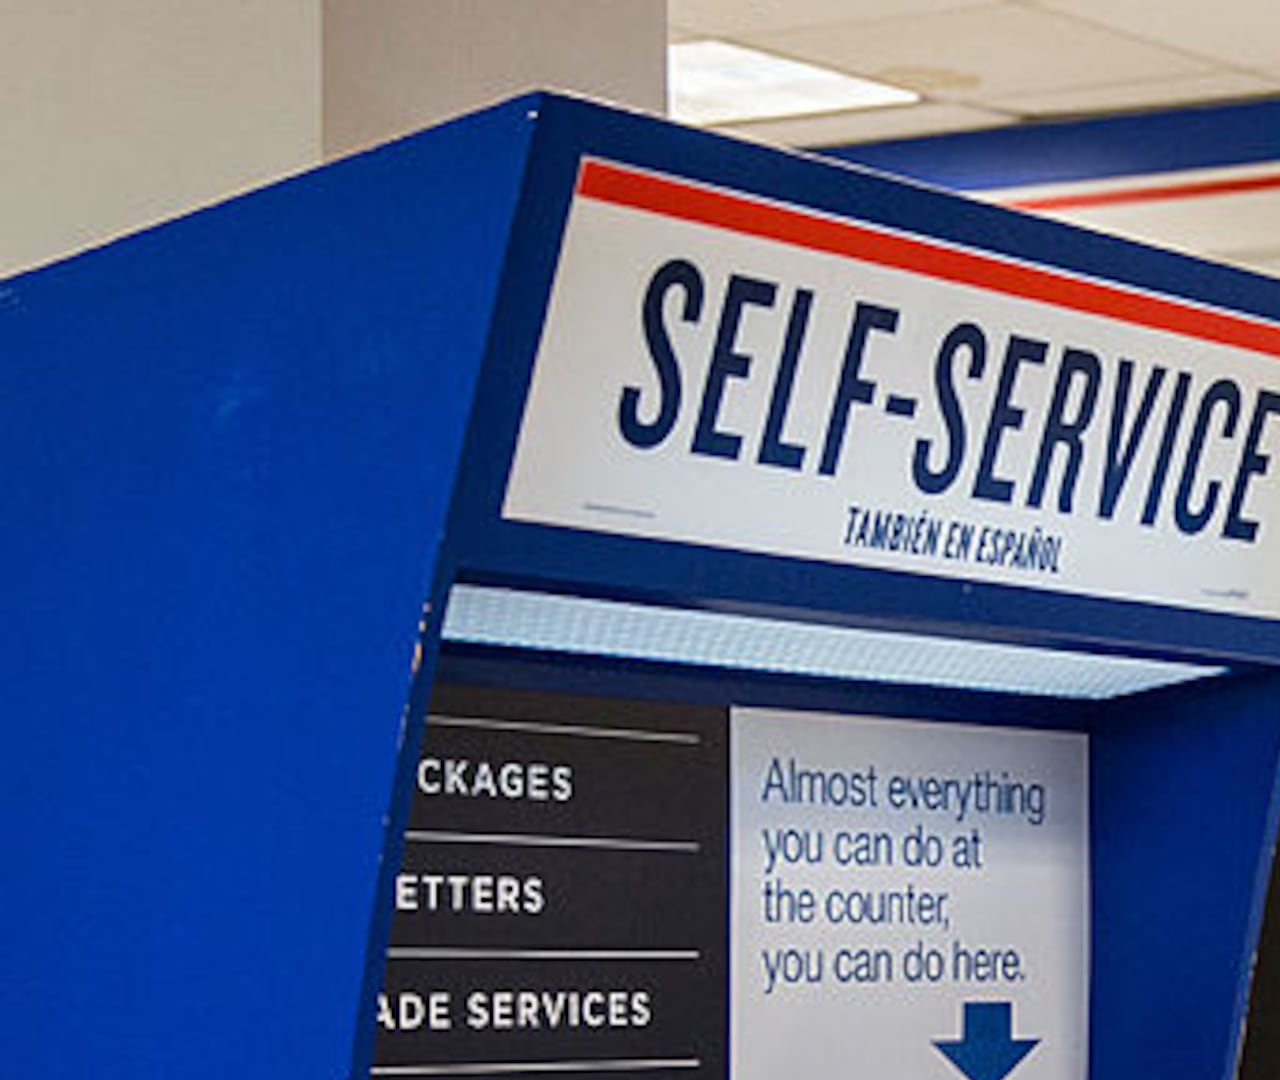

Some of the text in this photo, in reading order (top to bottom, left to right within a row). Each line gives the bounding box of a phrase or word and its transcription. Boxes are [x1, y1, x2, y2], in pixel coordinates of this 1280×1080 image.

[844, 506, 1062, 574] TAMBIÉN EN ESPAÑOL
[417, 759, 574, 801] CKAGES
[762, 757, 1046, 825] Almost everything
[762, 824, 983, 874] you can do at
[395, 874, 545, 913] ETTERS
[763, 878, 950, 930] the counter,
[762, 940, 1026, 995] you can do here.
[467, 991, 652, 1029] SERVICES
